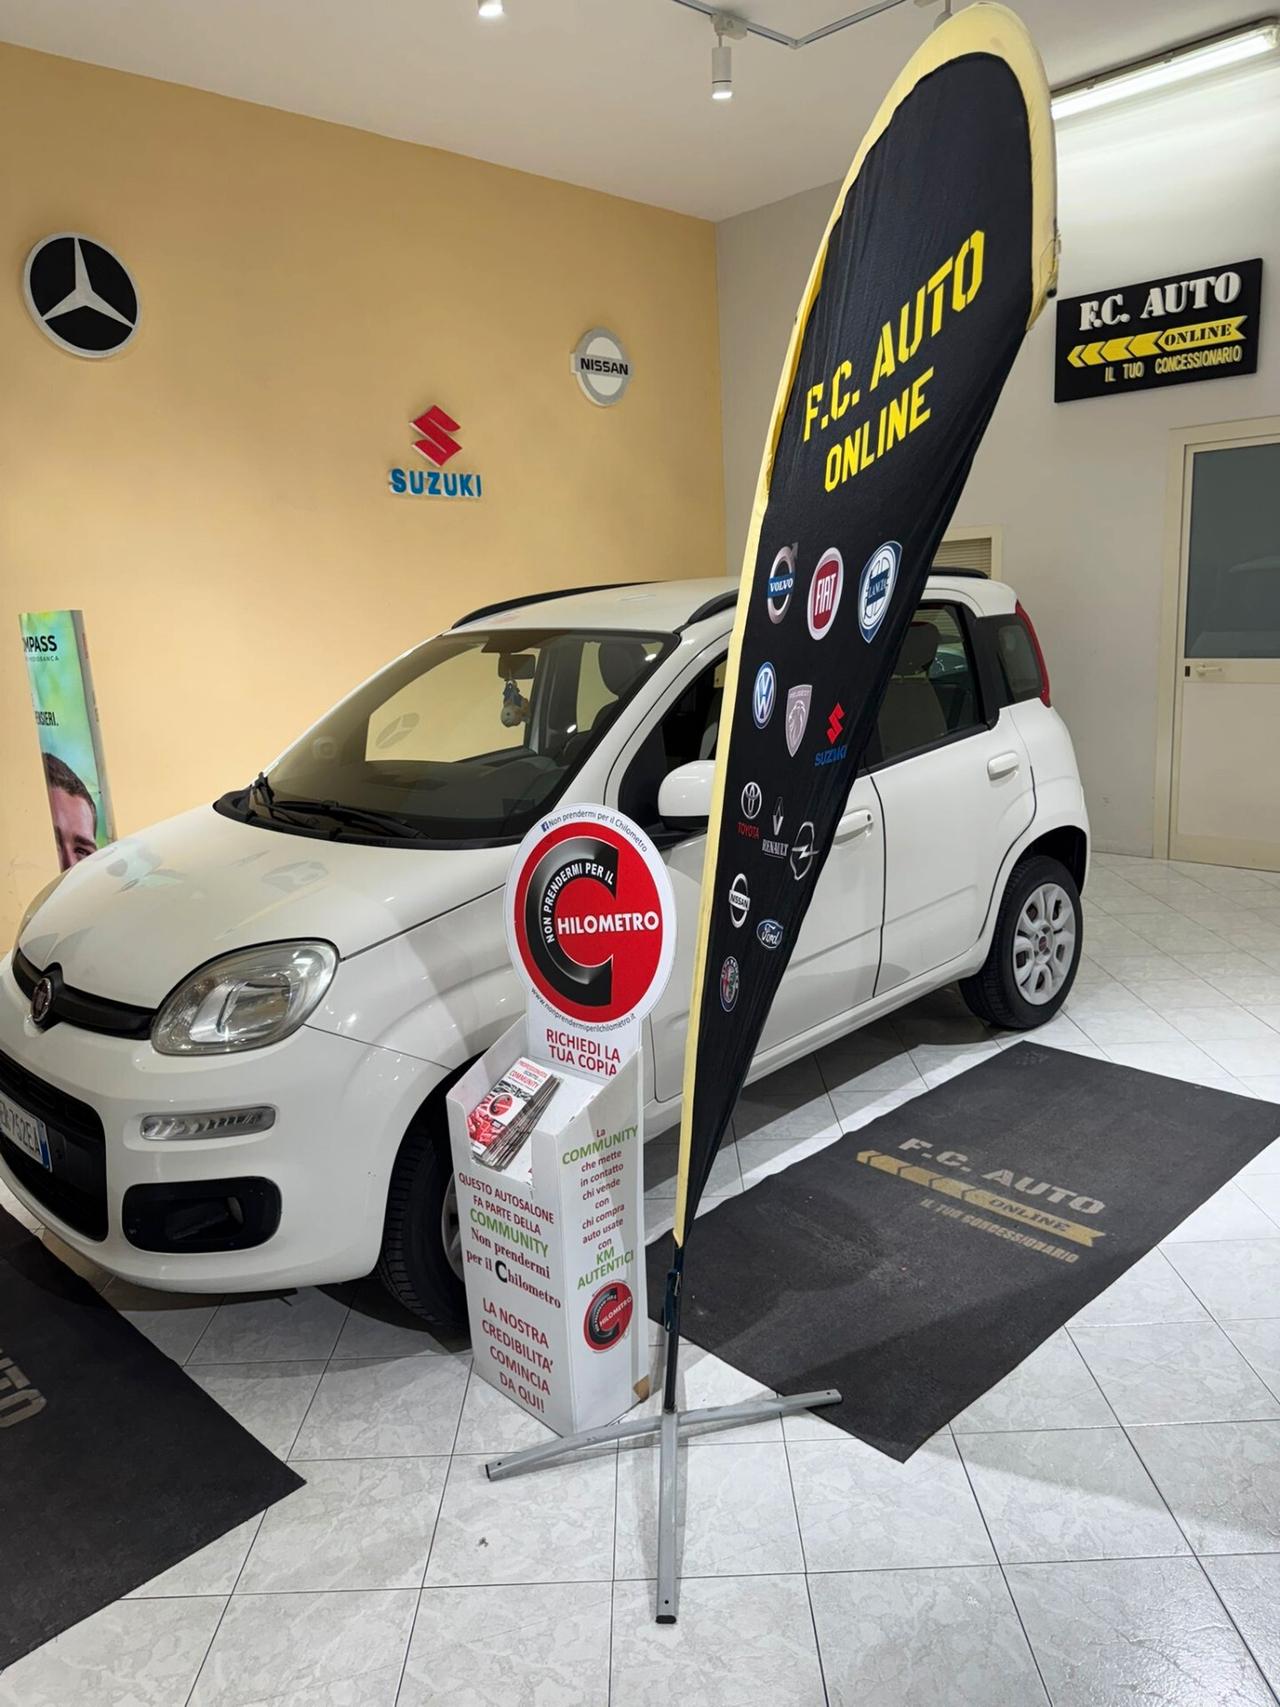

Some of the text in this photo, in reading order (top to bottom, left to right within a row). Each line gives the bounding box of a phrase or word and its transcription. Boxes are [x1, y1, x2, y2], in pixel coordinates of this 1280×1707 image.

[1079, 272, 1241, 331] F.C. AUTO
[803, 230, 985, 443] F.C. AUTO
[1164, 324, 1232, 347] ONLINE
[580, 357, 629, 375] NISSAN
[1105, 345, 1242, 383] IL TUO CONCESSIONARIO
[824, 366, 935, 493] ONLINE
[389, 468, 482, 497] SUZUKI
[769, 578, 793, 593] VOLVO
[814, 573, 837, 616] FIAT
[22, 635, 57, 652] MPASS
[814, 744, 848, 766] SUZUKI
[549, 810, 648, 853] Non prendermi per il Chilometro
[737, 822, 760, 839] TOYOTA
[762, 839, 789, 856] RENAULT
[543, 862, 615, 944] NON PRENDERMI PER IL
[730, 893, 749, 908] NISSAN
[761, 923, 780, 945] Ford
[546, 1028, 621, 1064] RICHIEDI LA
[548, 1045, 617, 1077] TUA COPIA
[562, 1124, 638, 1165] COMMUNITY
[596, 1128, 606, 1138] La
[580, 1163, 624, 1188] in contatto
[581, 1150, 622, 1172] che mette
[898, 1137, 1106, 1215] F.C. AUTO
[458, 1172, 555, 1225] QUESTO AUTOSALONE
[582, 1178, 621, 1201] chi vende
[595, 1197, 610, 1209] con
[470, 1208, 549, 1258] COMMUNITY
[473, 1195, 542, 1236] FA PARTE DELLA
[582, 1204, 625, 1230] chi compra
[582, 1218, 625, 1245] auto usate
[920, 1198, 1080, 1264] IL TUO CONCESSIONARIO
[988, 1197, 1072, 1233] ONLINE
[471, 1226, 551, 1280] Non prendermi
[596, 1246, 615, 1265] KM
[598, 1238, 612, 1250] con
[466, 1250, 561, 1309] per il Chilometro
[577, 1250, 634, 1290] AUTENTICI
[483, 1297, 550, 1349] LA NOSTRA
[489, 1345, 551, 1396] COMINCIA
[499, 1372, 545, 1414] DA QUI!
